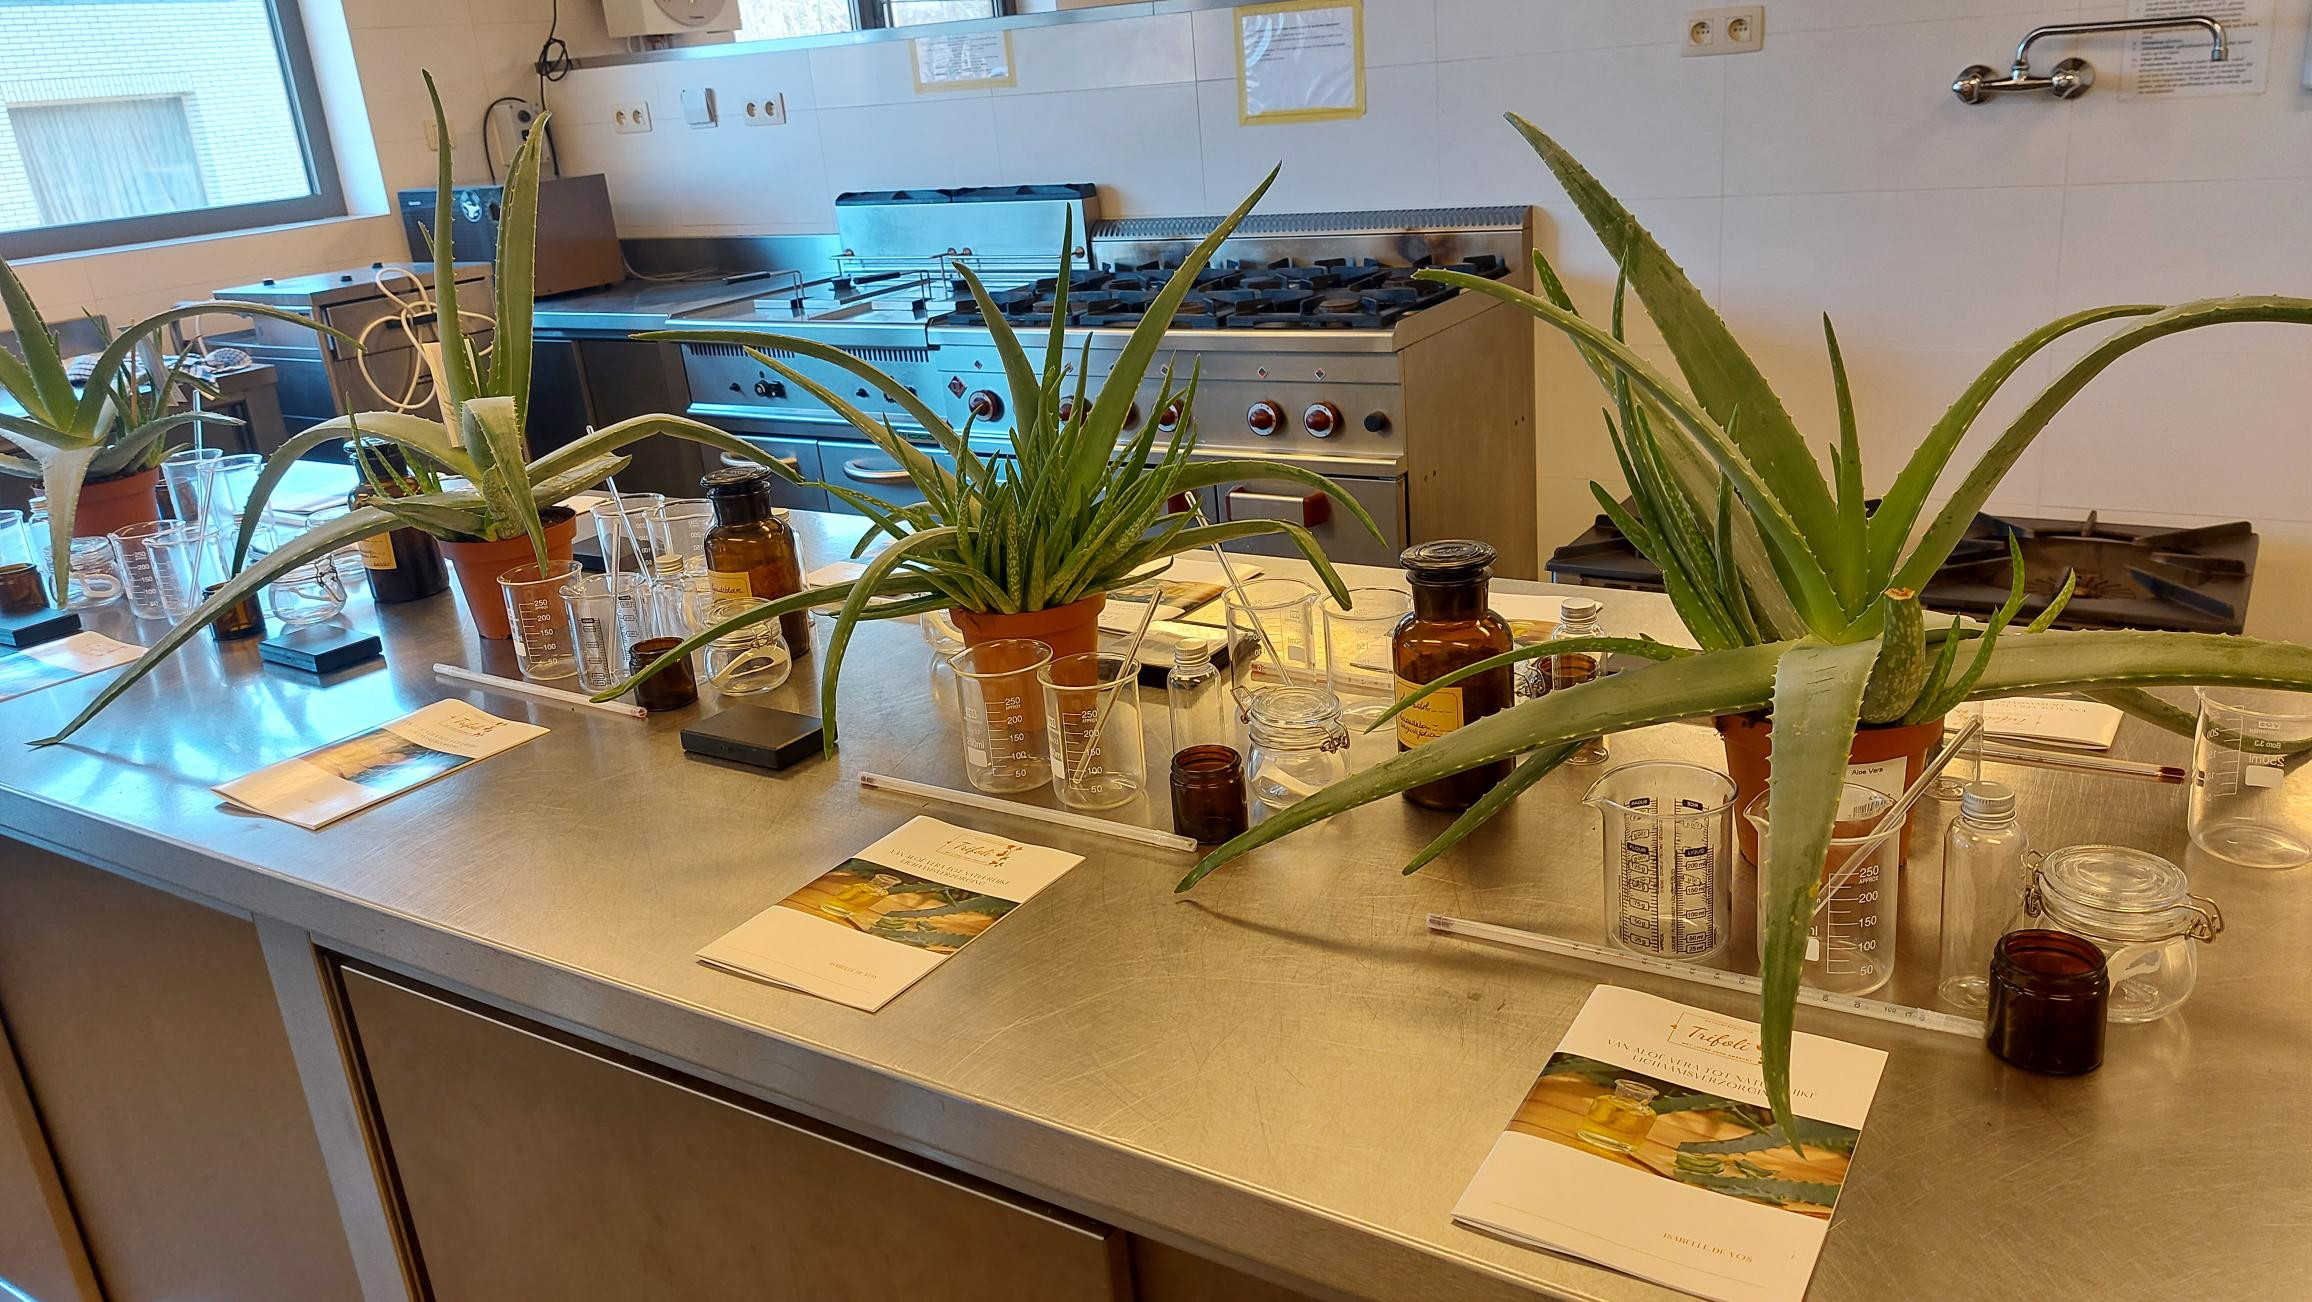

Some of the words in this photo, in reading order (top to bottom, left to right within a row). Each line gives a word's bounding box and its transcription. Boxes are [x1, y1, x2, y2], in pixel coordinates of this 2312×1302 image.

[537, 614, 551, 622] 200
[540, 628, 554, 636] 150
[543, 643, 557, 651] 100
[1004, 696, 1021, 705] 250
[1081, 710, 1098, 719] 250
[1007, 715, 1023, 725] 200
[1009, 733, 1025, 742] 150
[1083, 729, 1100, 738] 200
[1011, 751, 1026, 760] 100
[1086, 748, 1101, 756] 150
[1015, 769, 1027, 778] 50
[1087, 766, 1103, 775] 100
[1091, 785, 1103, 793] 50
[953, 841, 994, 858] Trifoli
[1859, 865, 1880, 878] 250
[1859, 876, 1879, 885] APPROX
[1858, 891, 1879, 904] 200
[1858, 915, 1877, 927] 150
[1857, 940, 1876, 952] 100
[1860, 964, 1874, 976] 50
[1687, 1025, 1752, 1051] Trifoli
[1608, 1039, 1629, 1050] VAN
[1636, 1047, 1666, 1060] ALOE
[1671, 1057, 1699, 1071] VERA
[1706, 1067, 1730, 1079] TOT
[1663, 1232, 1708, 1251] ISABELLE
[1712, 1247, 1724, 1256] DE
[1730, 1251, 1752, 1263] VOS
